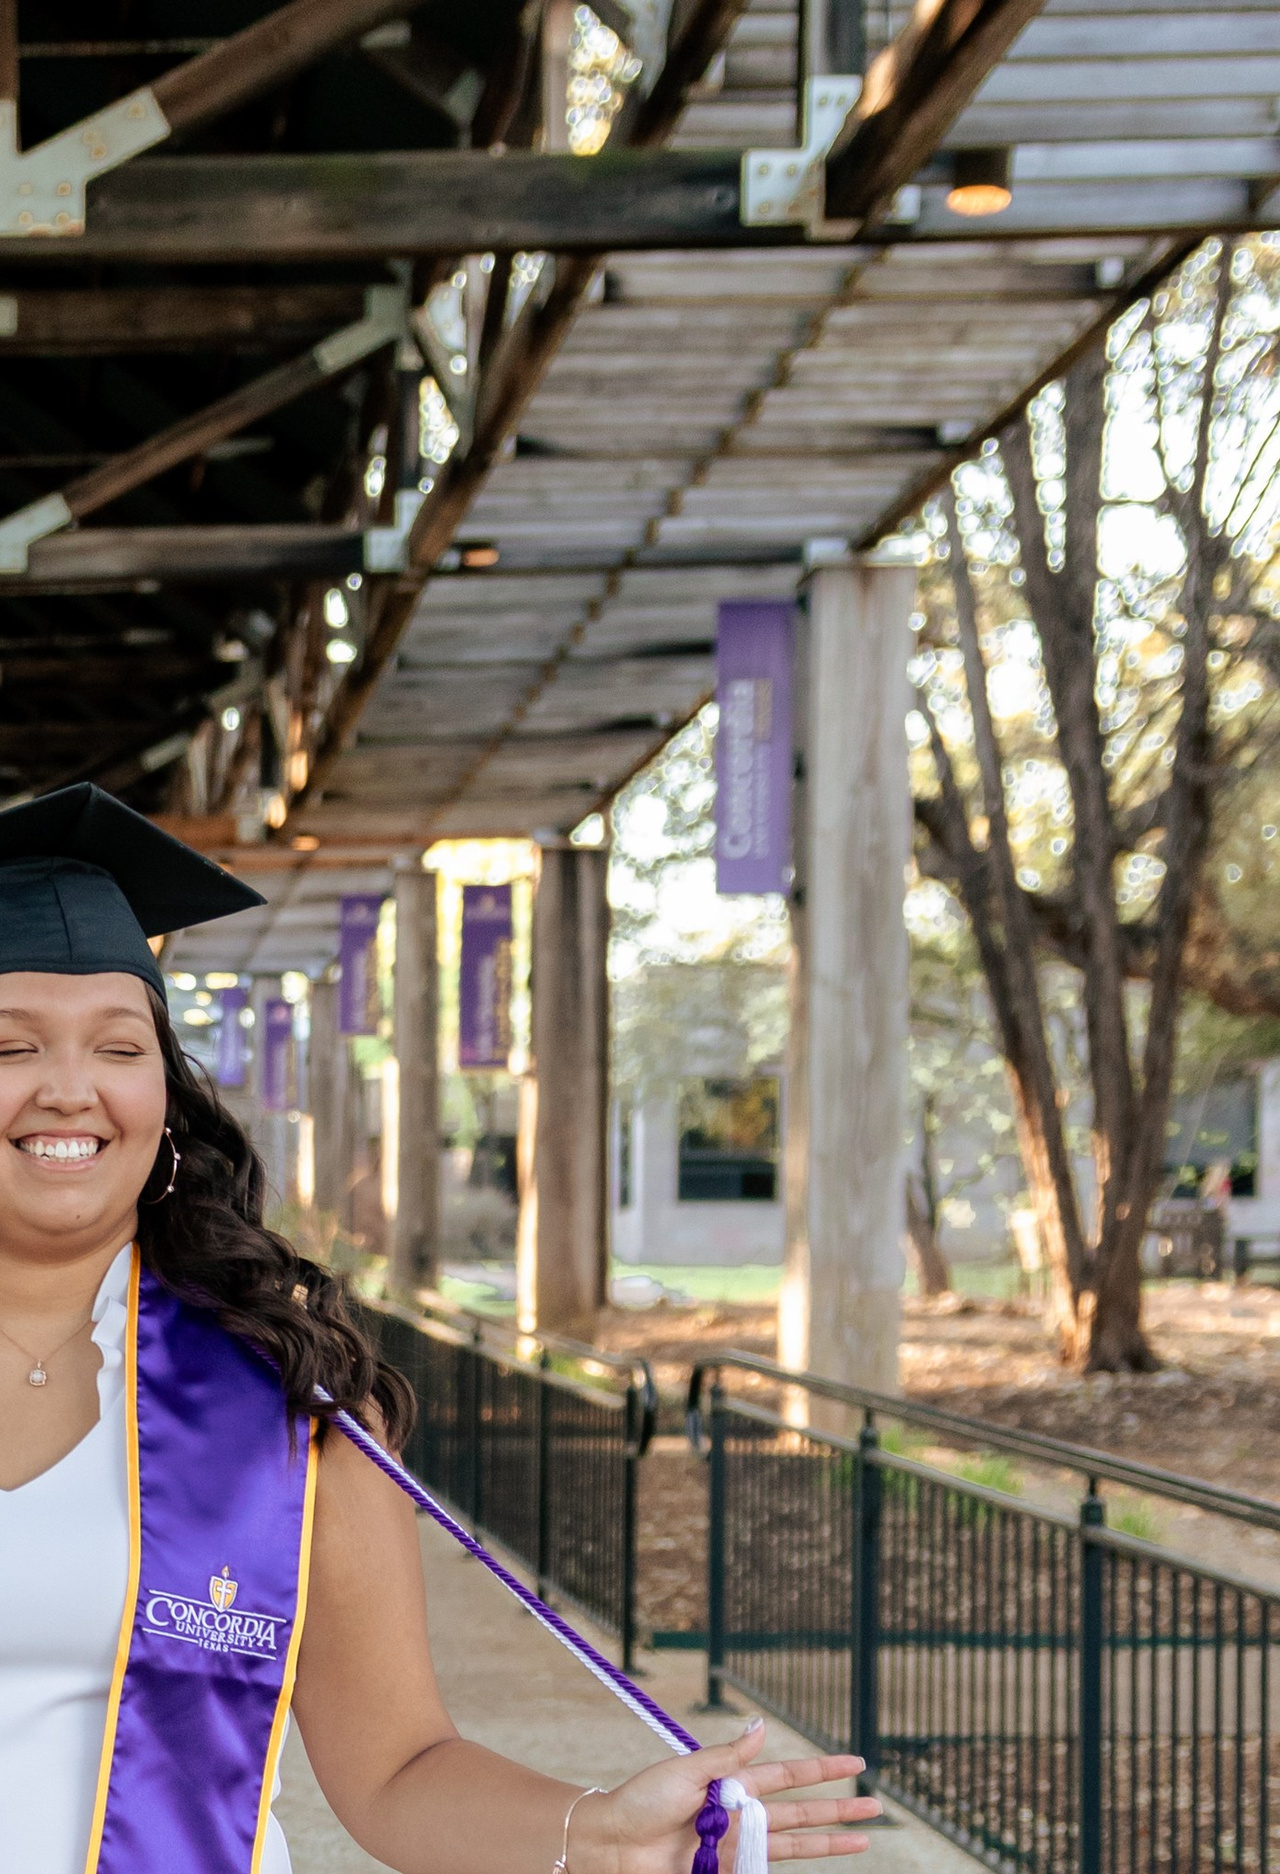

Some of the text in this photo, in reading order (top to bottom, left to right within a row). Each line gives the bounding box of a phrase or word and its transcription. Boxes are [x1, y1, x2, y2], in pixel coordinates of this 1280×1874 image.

[146, 1596, 277, 1650] CONCORDIA
[175, 1620, 257, 1648] UNIVERSITY
[198, 1638, 230, 1653] TEXAS
